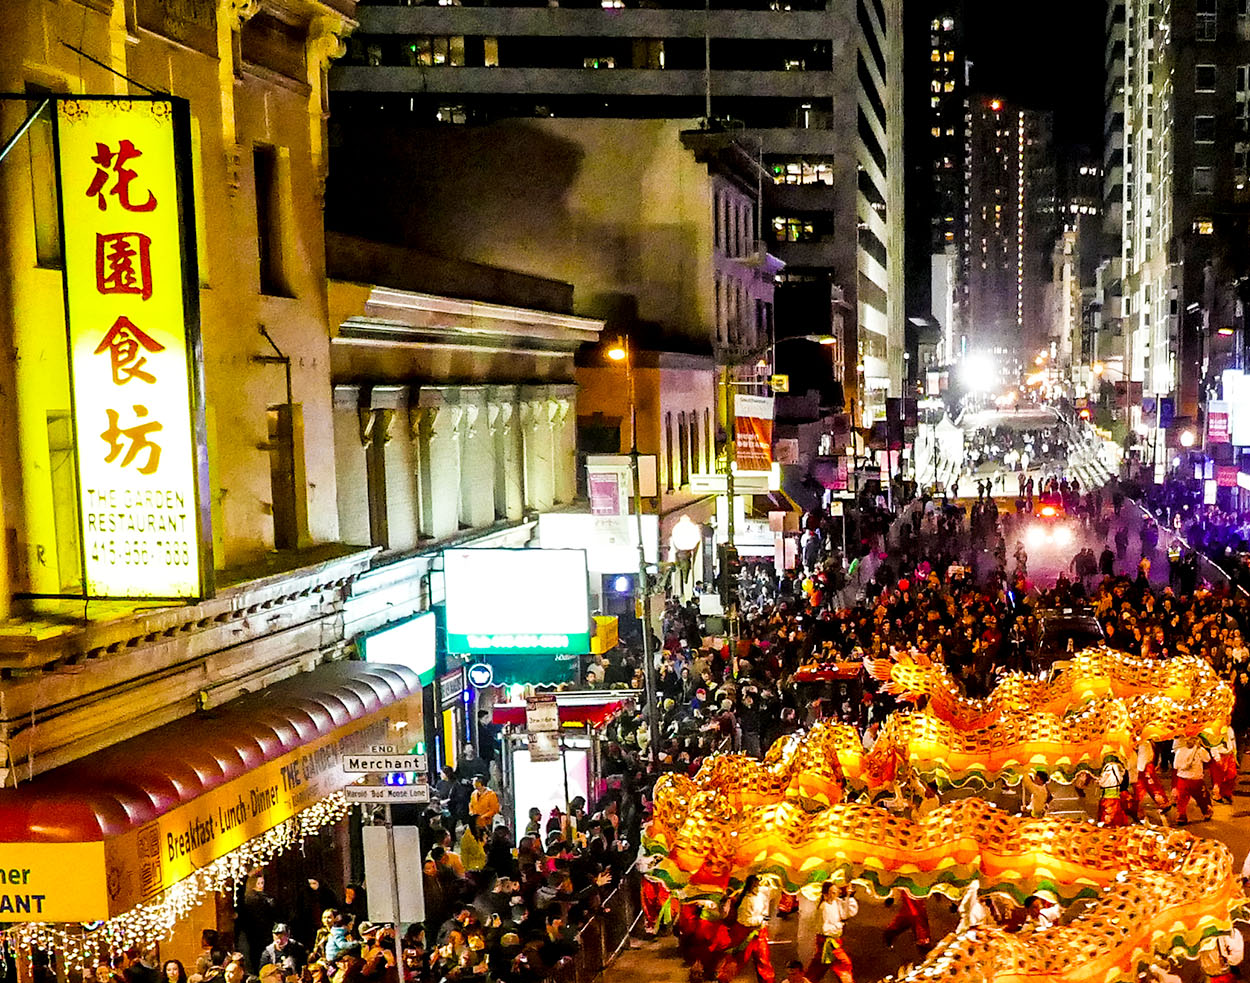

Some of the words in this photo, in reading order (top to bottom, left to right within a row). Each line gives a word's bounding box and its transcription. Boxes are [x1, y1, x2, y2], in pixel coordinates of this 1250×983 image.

[86, 139, 166, 475] 花園食坊
[87, 489, 117, 508] THE
[125, 489, 184, 508] GARDEN
[88, 513, 186, 532] RESTAURANT
[349, 758, 419, 769] Merchant
[167, 814, 215, 862] Breakfast
[219, 795, 247, 834] Lunch
[250, 785, 279, 817] Dinner
[280, 760, 301, 793] THE
[0, 895, 46, 914] ANT
